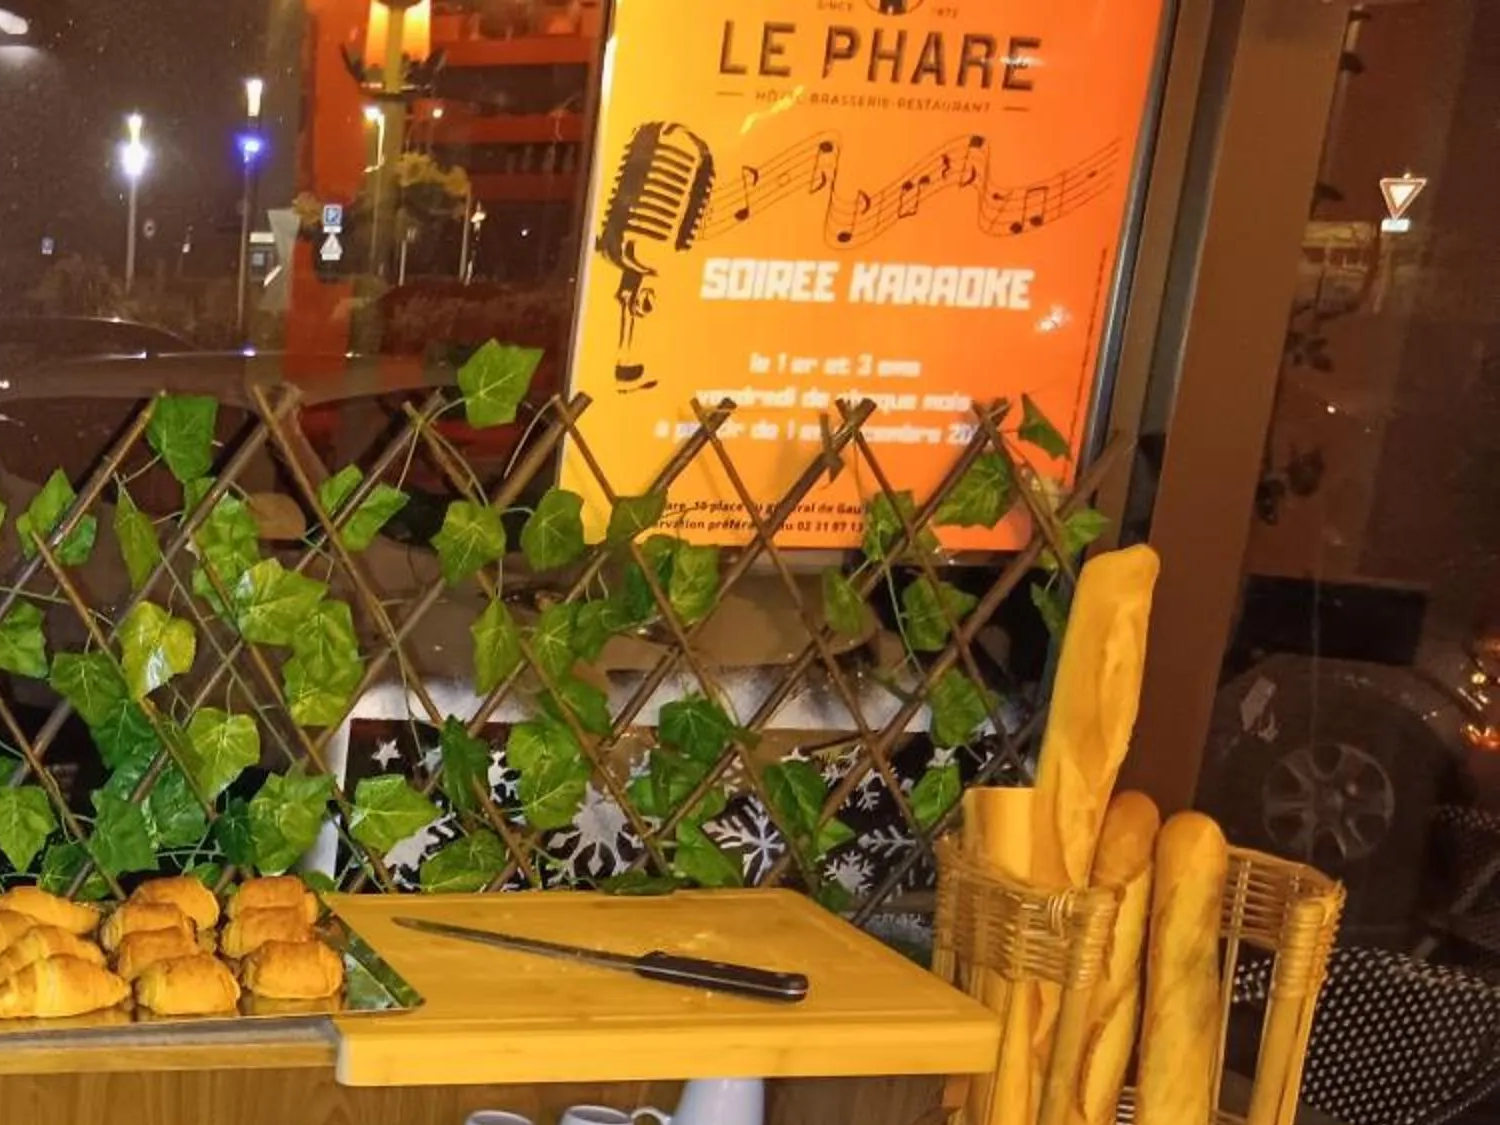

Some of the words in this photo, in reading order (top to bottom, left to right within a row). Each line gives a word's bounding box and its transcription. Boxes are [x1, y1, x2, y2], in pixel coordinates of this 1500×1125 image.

[719, 20, 796, 77] LE
[822, 25, 1042, 92] PHARE
[702, 258, 840, 302] SOIREE
[850, 262, 1034, 310] KARAOKE
[802, 390, 830, 408] de
[751, 420, 778, 440] de
